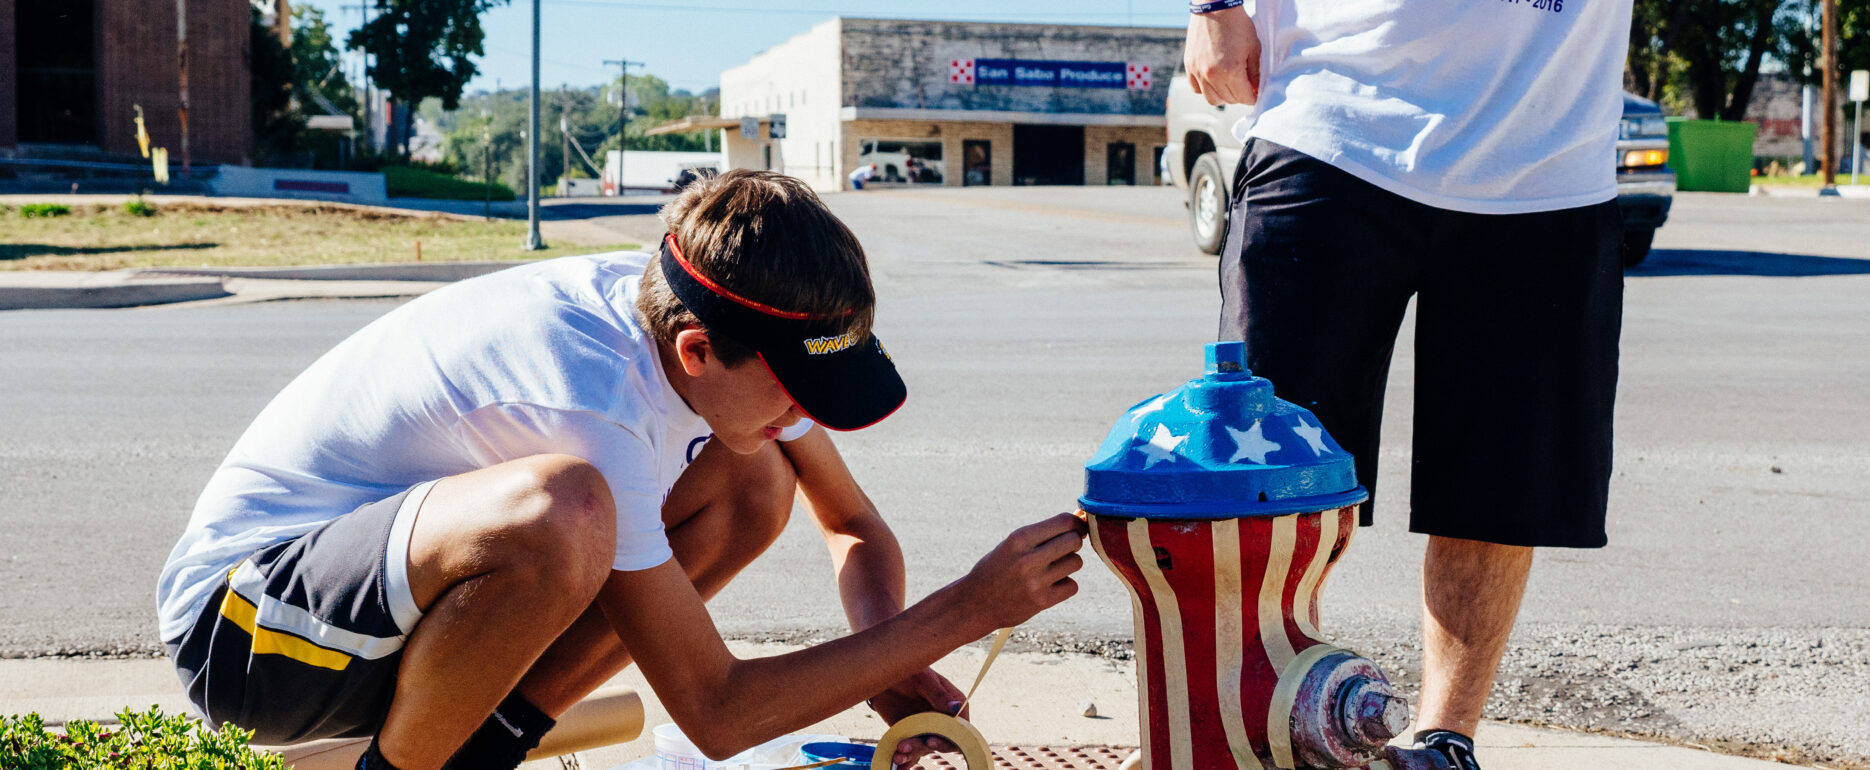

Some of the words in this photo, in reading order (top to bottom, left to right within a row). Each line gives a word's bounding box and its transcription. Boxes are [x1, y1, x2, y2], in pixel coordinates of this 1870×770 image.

[1532, 0, 1563, 12] 2016
[978, 65, 1008, 79] San
[1014, 66, 1054, 80] Saba
[1060, 68, 1123, 82] Produce
